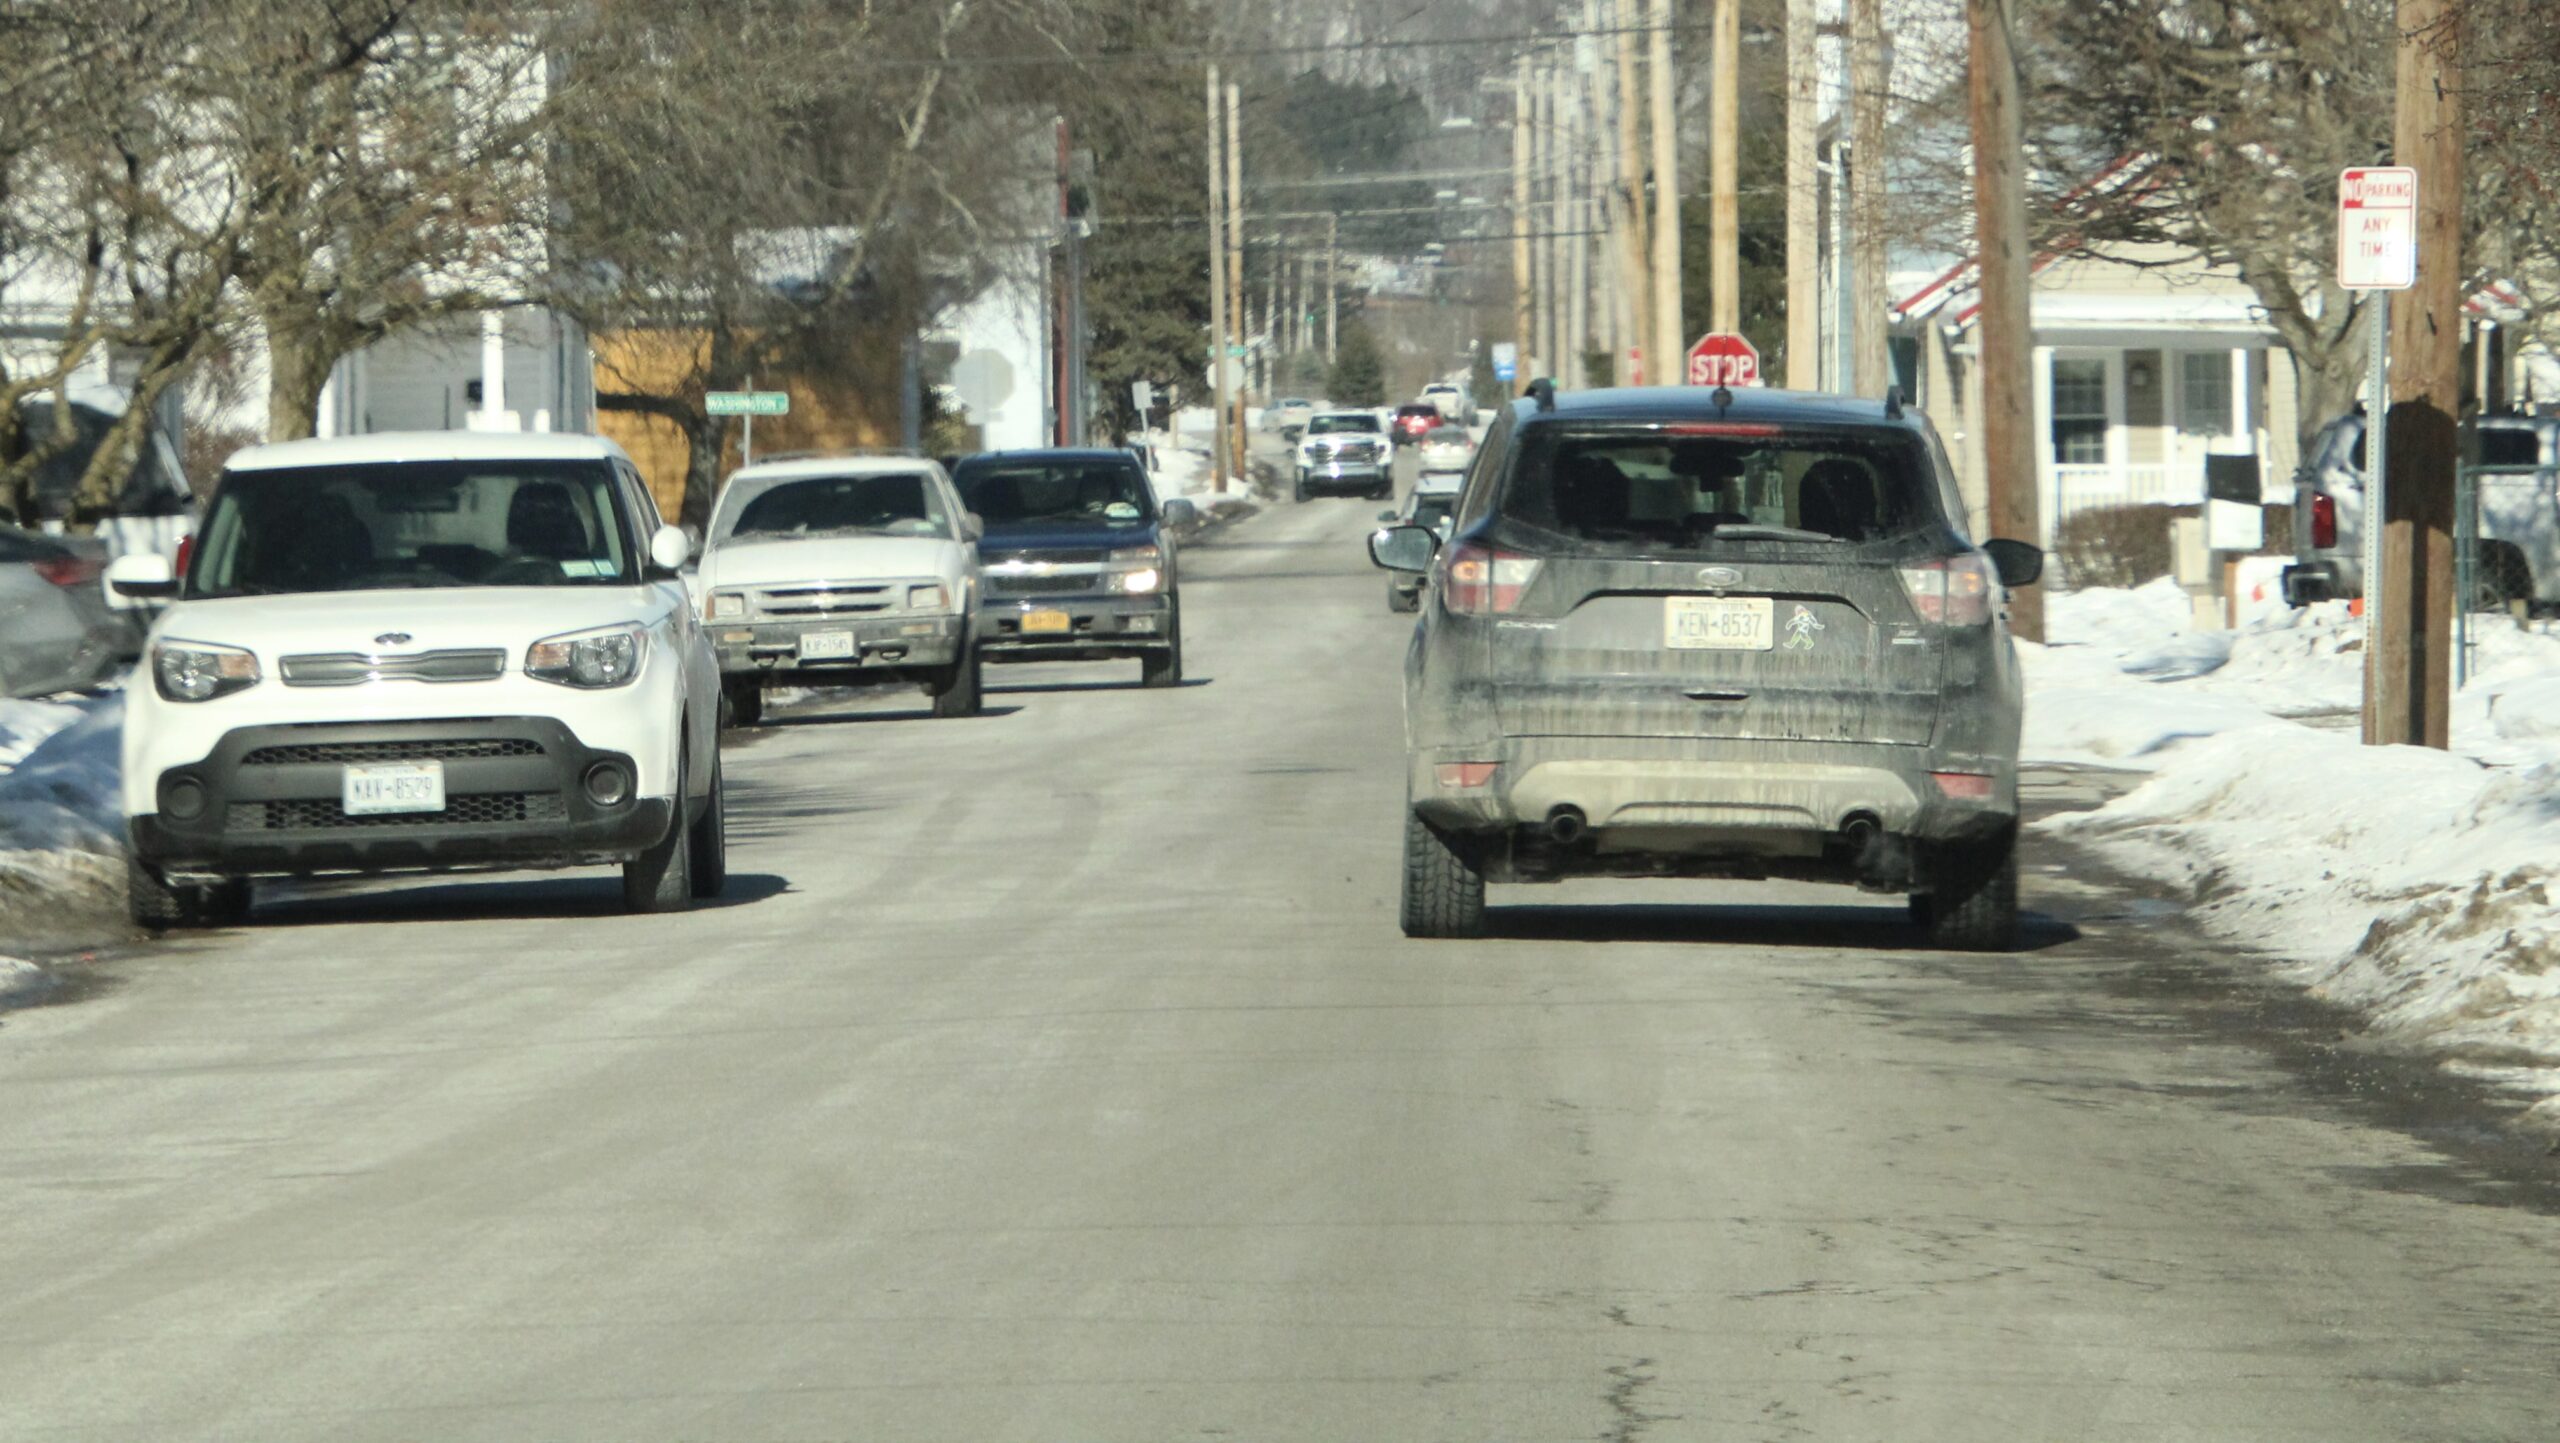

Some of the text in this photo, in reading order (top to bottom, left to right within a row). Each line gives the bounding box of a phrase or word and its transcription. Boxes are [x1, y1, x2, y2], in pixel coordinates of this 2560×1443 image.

[2365, 183, 2410, 198] PARKING
[2362, 217, 2391, 232] ANY
[2360, 241, 2392, 257] TIME
[1692, 354, 1754, 383] STOP
[708, 397, 776, 411] WASHINGTON
